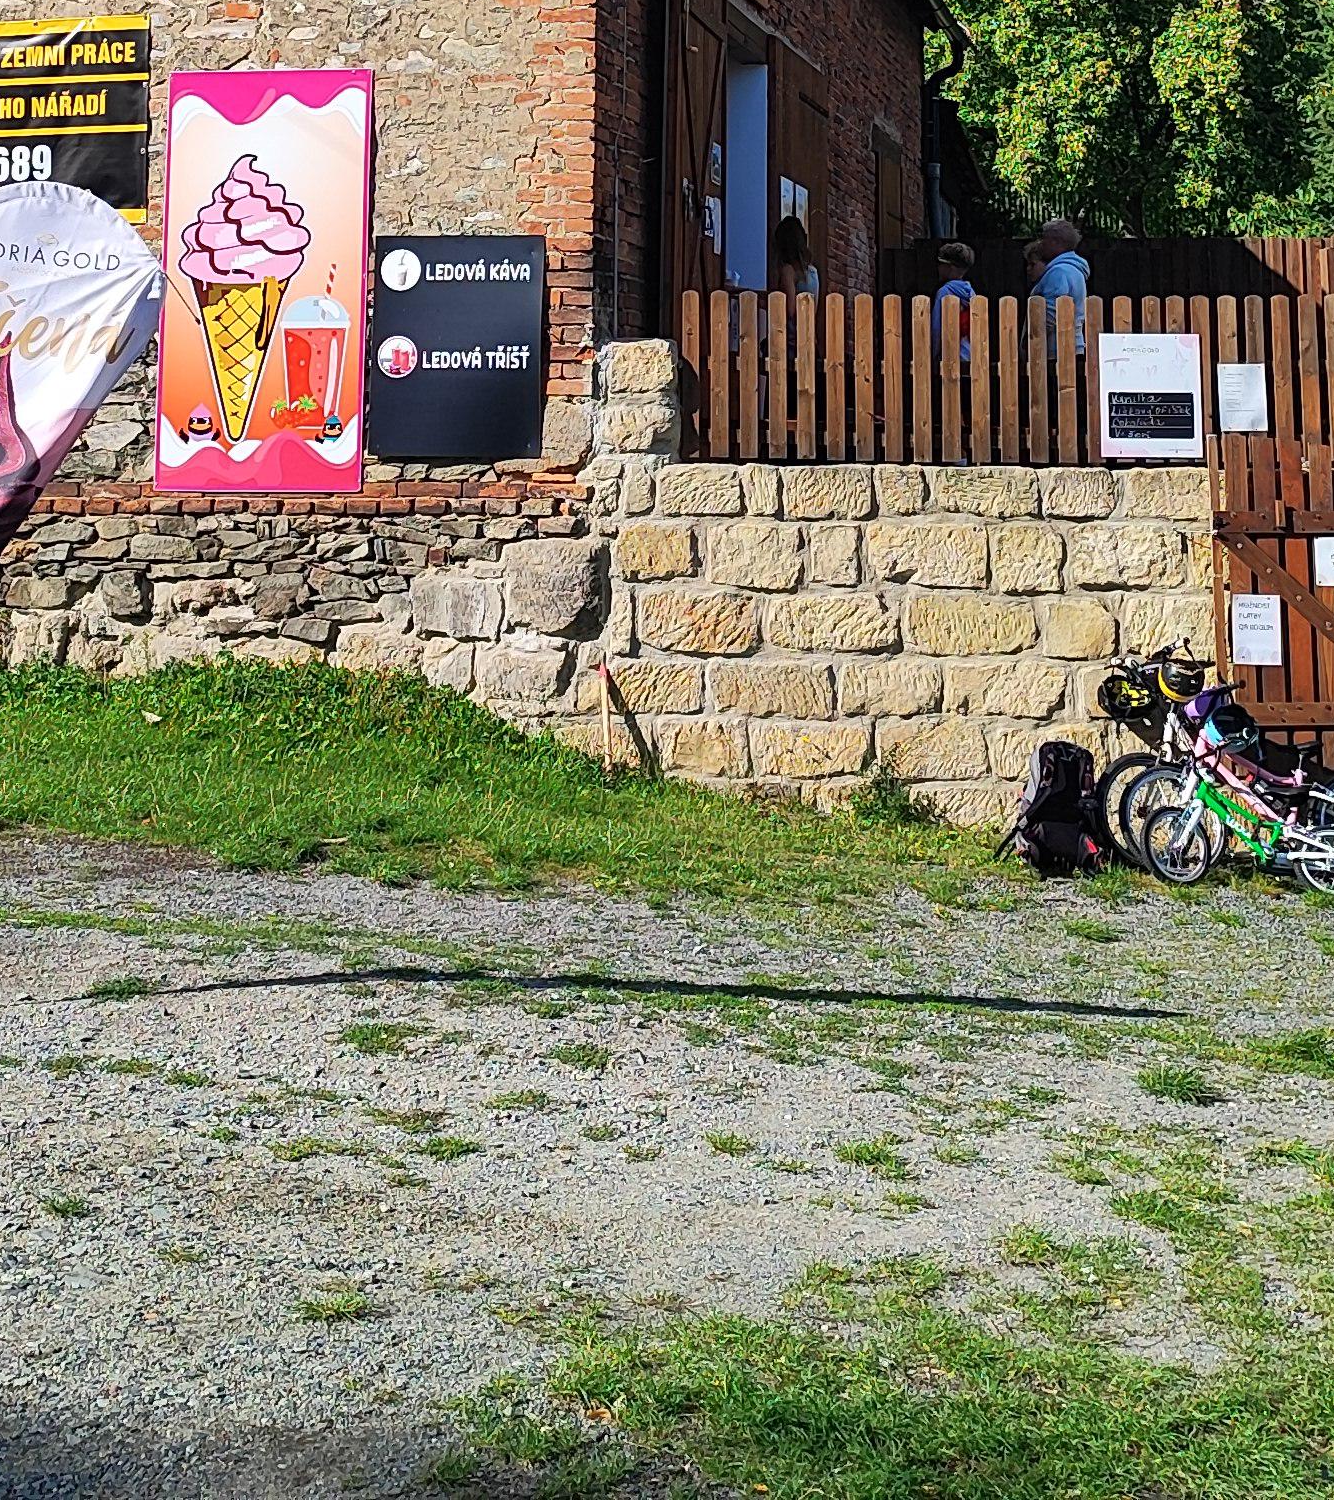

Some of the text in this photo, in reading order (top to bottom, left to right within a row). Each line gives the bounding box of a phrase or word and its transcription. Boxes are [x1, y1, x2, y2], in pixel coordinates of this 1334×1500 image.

[1, 43, 66, 68] ZEMNÍ
[71, 41, 136, 65] PRÁCE
[31, 89, 108, 118] NÁŘADÍ
[53, 250, 121, 271] GOLD
[425, 259, 531, 282] LEDOVÁ KÁVA
[422, 347, 481, 369] LEDOVÁ
